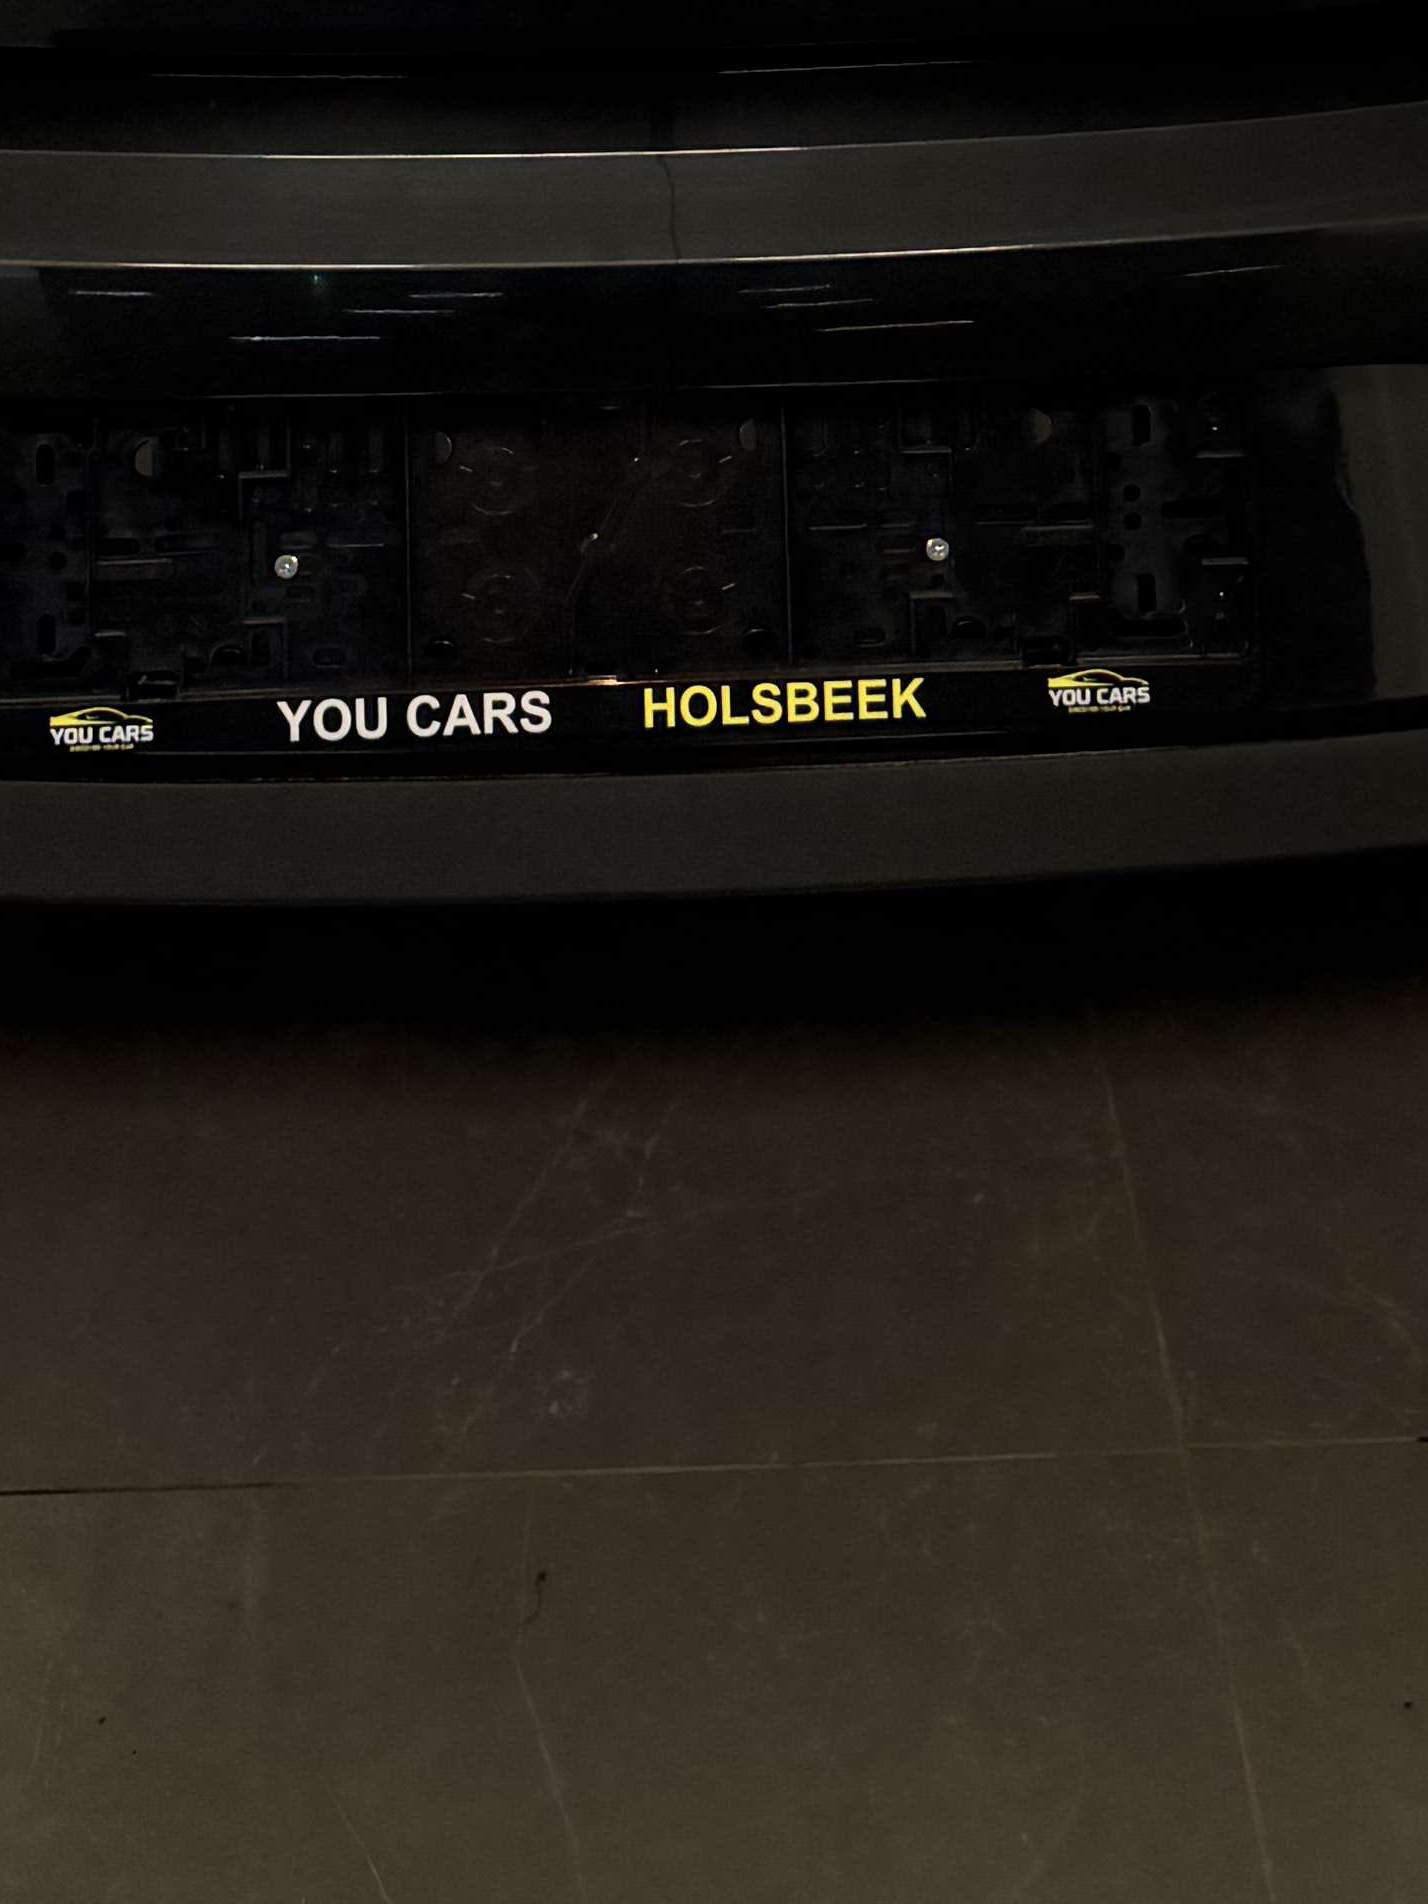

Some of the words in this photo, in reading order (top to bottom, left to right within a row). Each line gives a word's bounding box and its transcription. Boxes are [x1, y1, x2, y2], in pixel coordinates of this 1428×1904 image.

[643, 677, 926, 728] HOLSBEEK
[1048, 688, 1091, 707] YOU
[1096, 686, 1151, 705] CARS
[50, 726, 94, 745] YOU
[98, 724, 154, 743] CARS
[277, 697, 387, 742] YOU
[406, 691, 552, 737] CARS
